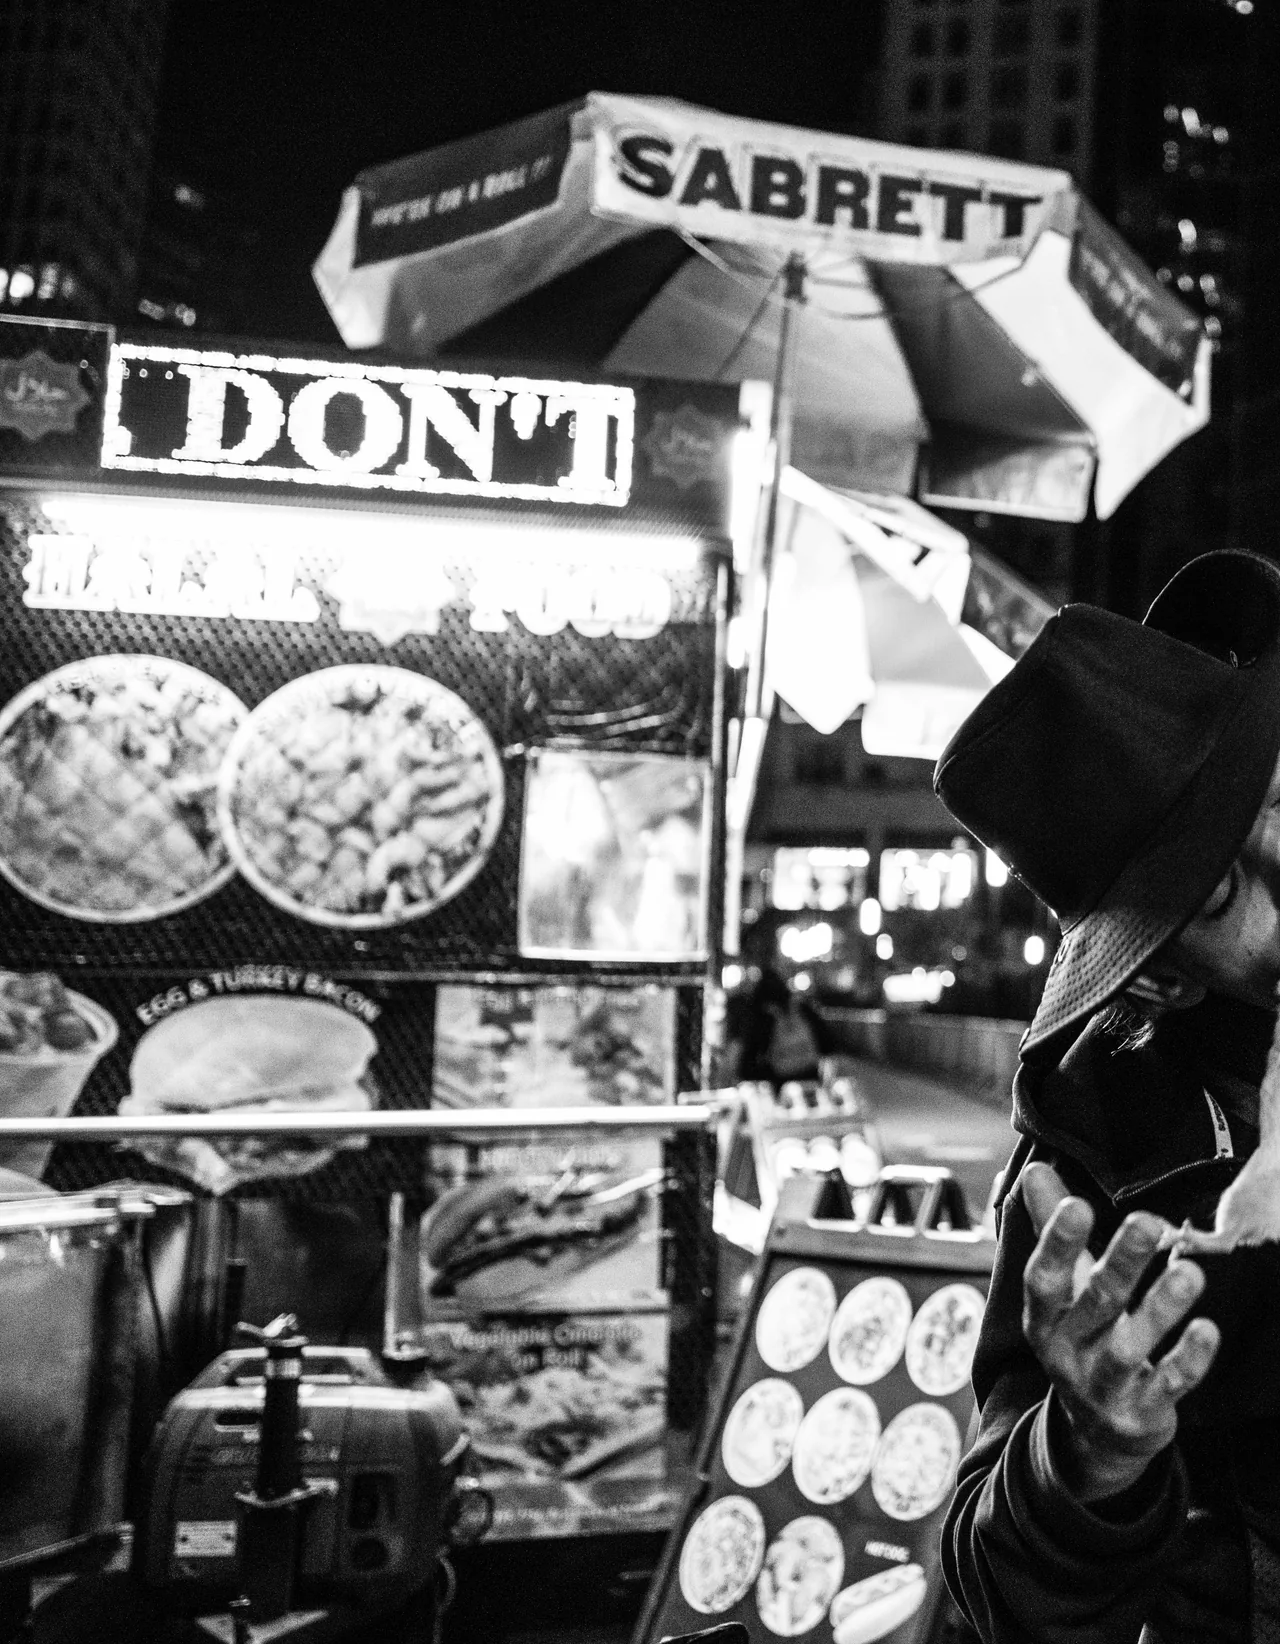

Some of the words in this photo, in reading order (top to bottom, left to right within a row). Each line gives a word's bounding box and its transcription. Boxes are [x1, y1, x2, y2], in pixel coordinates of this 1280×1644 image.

[618, 135, 1043, 242] SABRETT
[172, 363, 620, 490] DON'T
[136, 985, 188, 1026] EGG
[208, 963, 301, 993] TURKEY
[303, 972, 382, 1024] BACON
